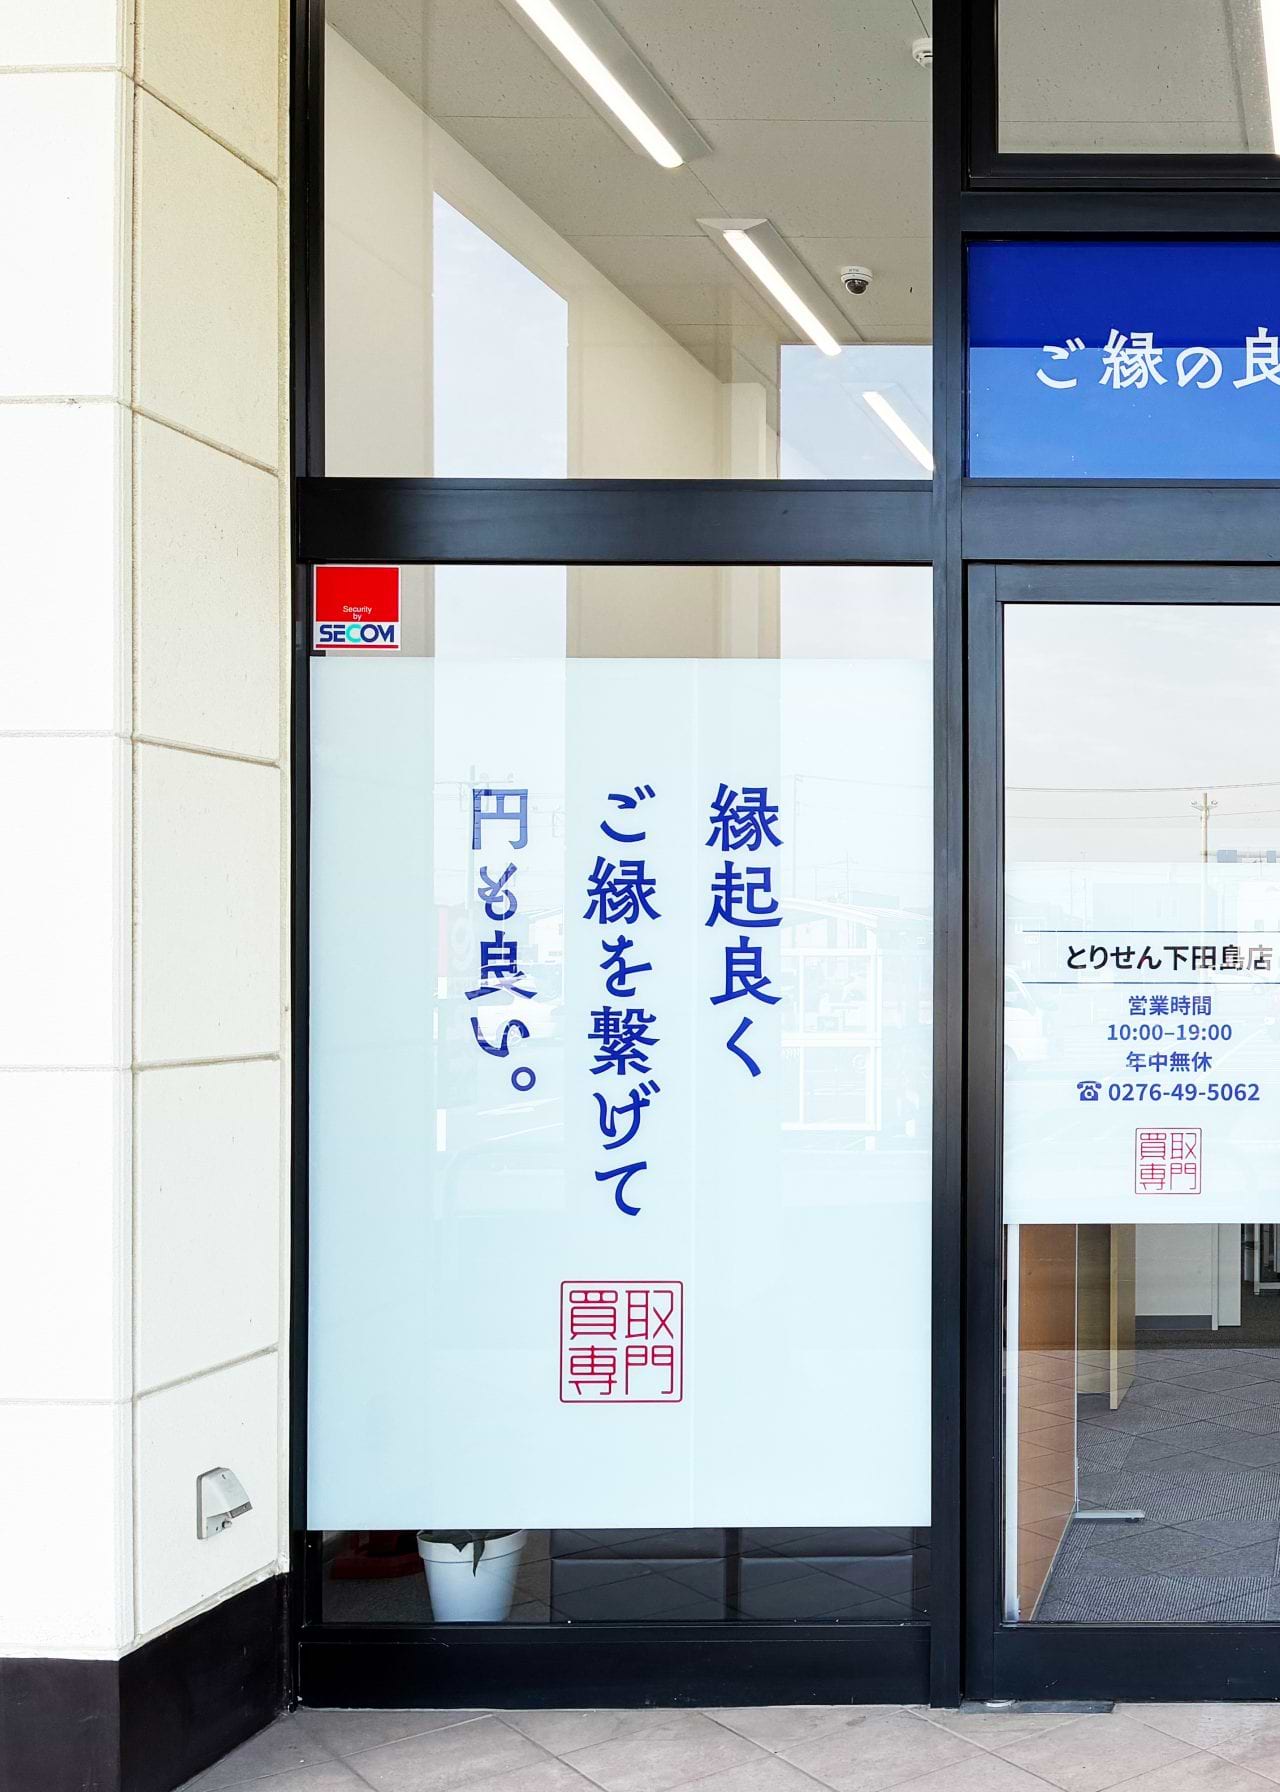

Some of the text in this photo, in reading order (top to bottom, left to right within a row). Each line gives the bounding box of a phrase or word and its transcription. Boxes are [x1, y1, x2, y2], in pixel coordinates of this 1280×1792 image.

[343, 605, 372, 614] Security
[319, 623, 395, 643] SECOM
[705, 783, 784, 1077] 縁起良く
[1066, 944, 1272, 971] とりせん下田島店
[583, 785, 662, 1216] ご縁を繋げて
[1128, 995, 1212, 1016] 営業時間
[1125, 1050, 1213, 1073] 年中無休
[1108, 1083, 1261, 1102] 0276-49-5062
[1139, 1132, 1197, 1160] 買取
[1139, 1162, 1197, 1190] 専門
[568, 1289, 674, 1340] 買取
[568, 1344, 674, 1396] 専門
